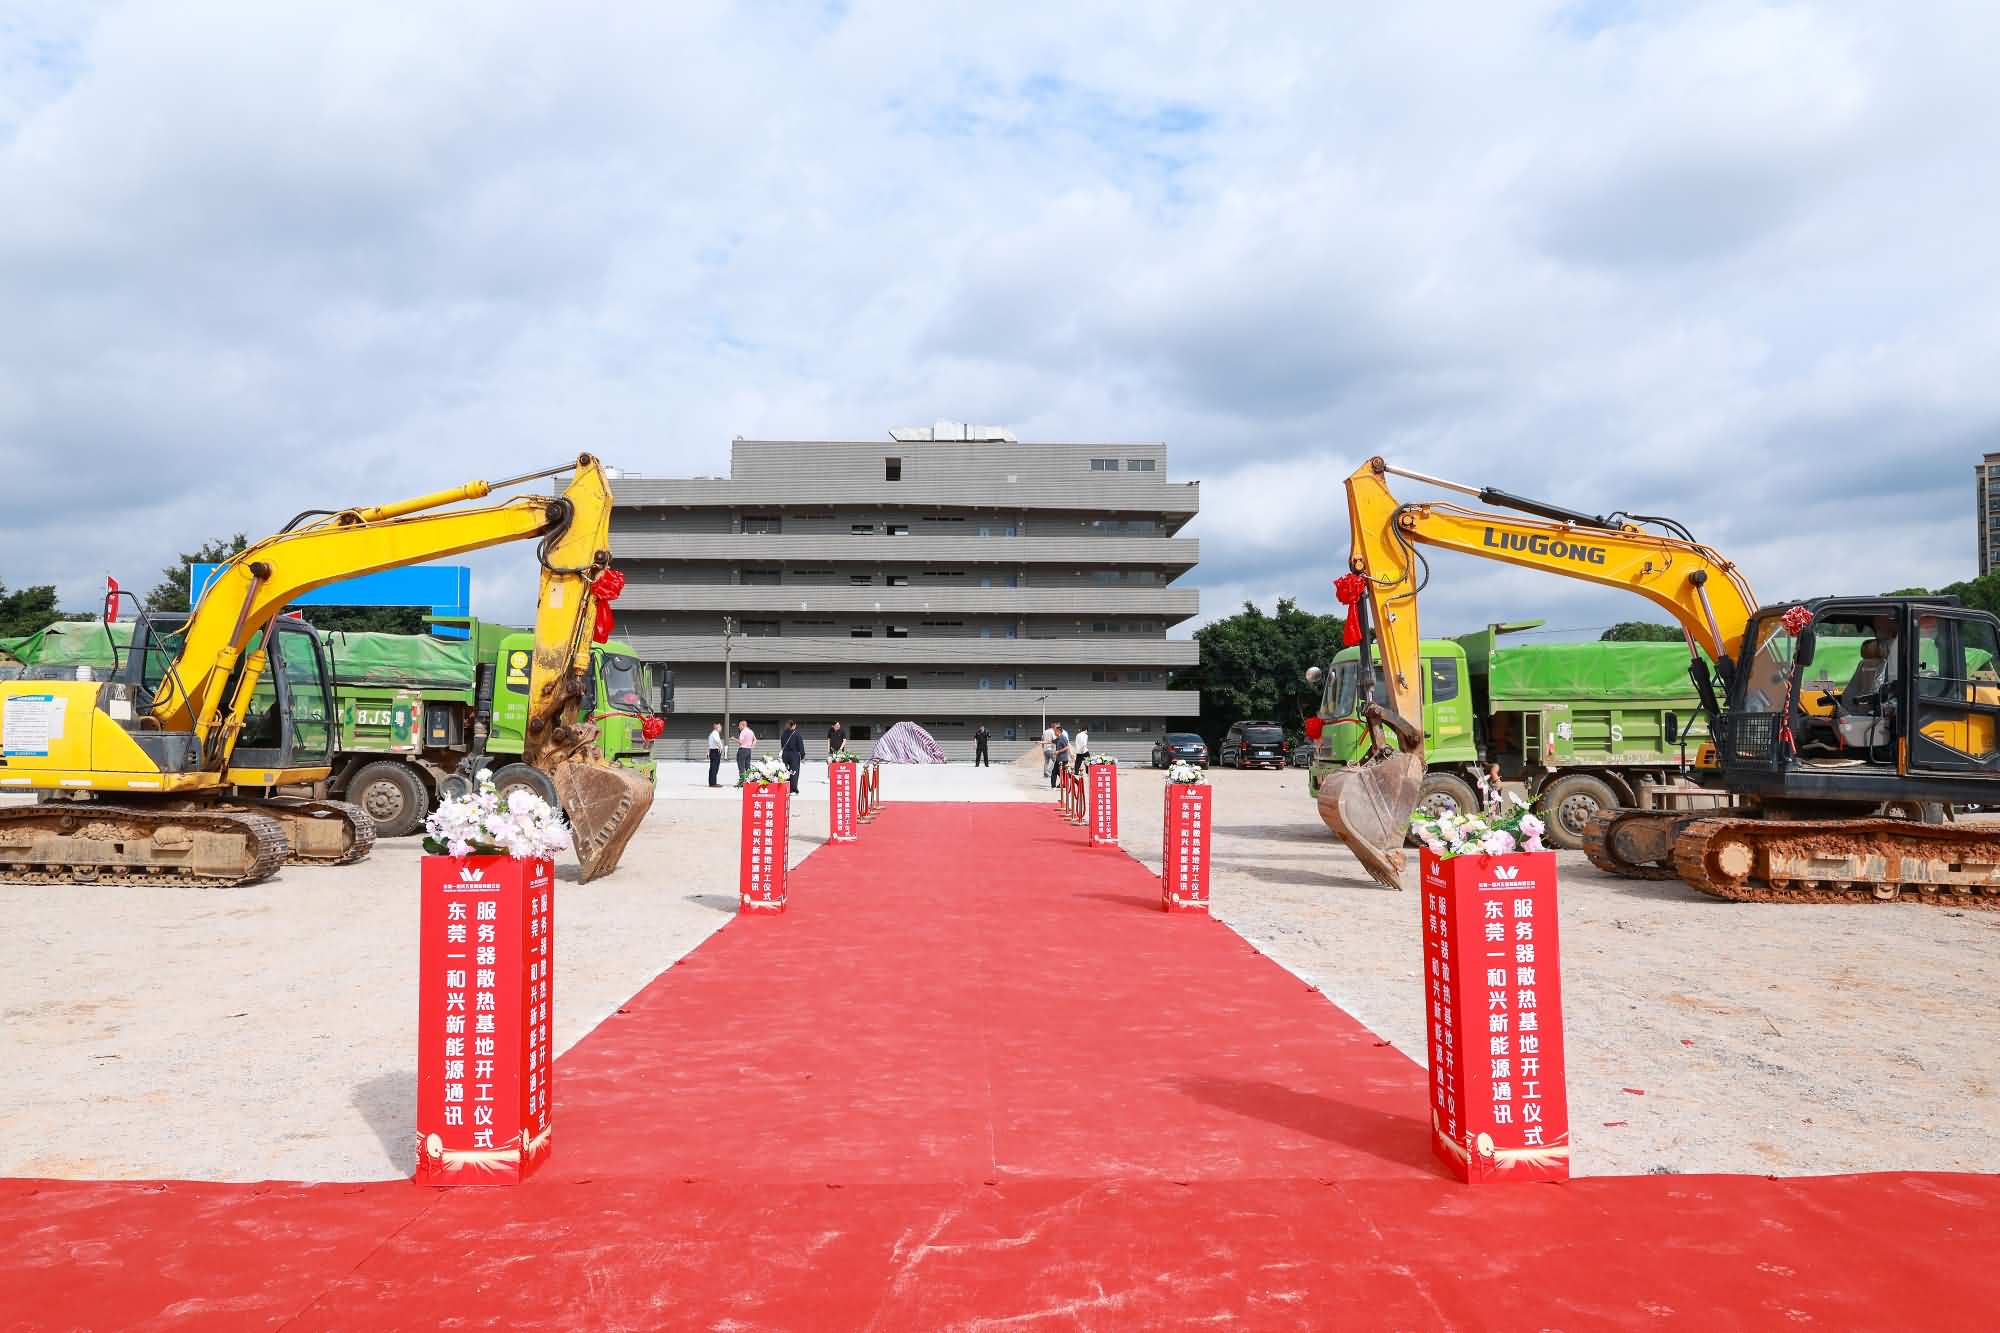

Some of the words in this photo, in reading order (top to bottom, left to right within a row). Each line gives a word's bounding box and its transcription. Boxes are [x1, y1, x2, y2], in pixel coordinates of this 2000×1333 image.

[1483, 526, 1606, 565] LIUGONG
[444, 902, 467, 1126] 东莞一和兴新能源通讯
[473, 902, 497, 1149] 服务器散热基地开工仪式
[1484, 900, 1513, 1124] 东莞一和兴新能源通讯
[1514, 898, 1544, 1146] 服务器散热基地开工仪式
